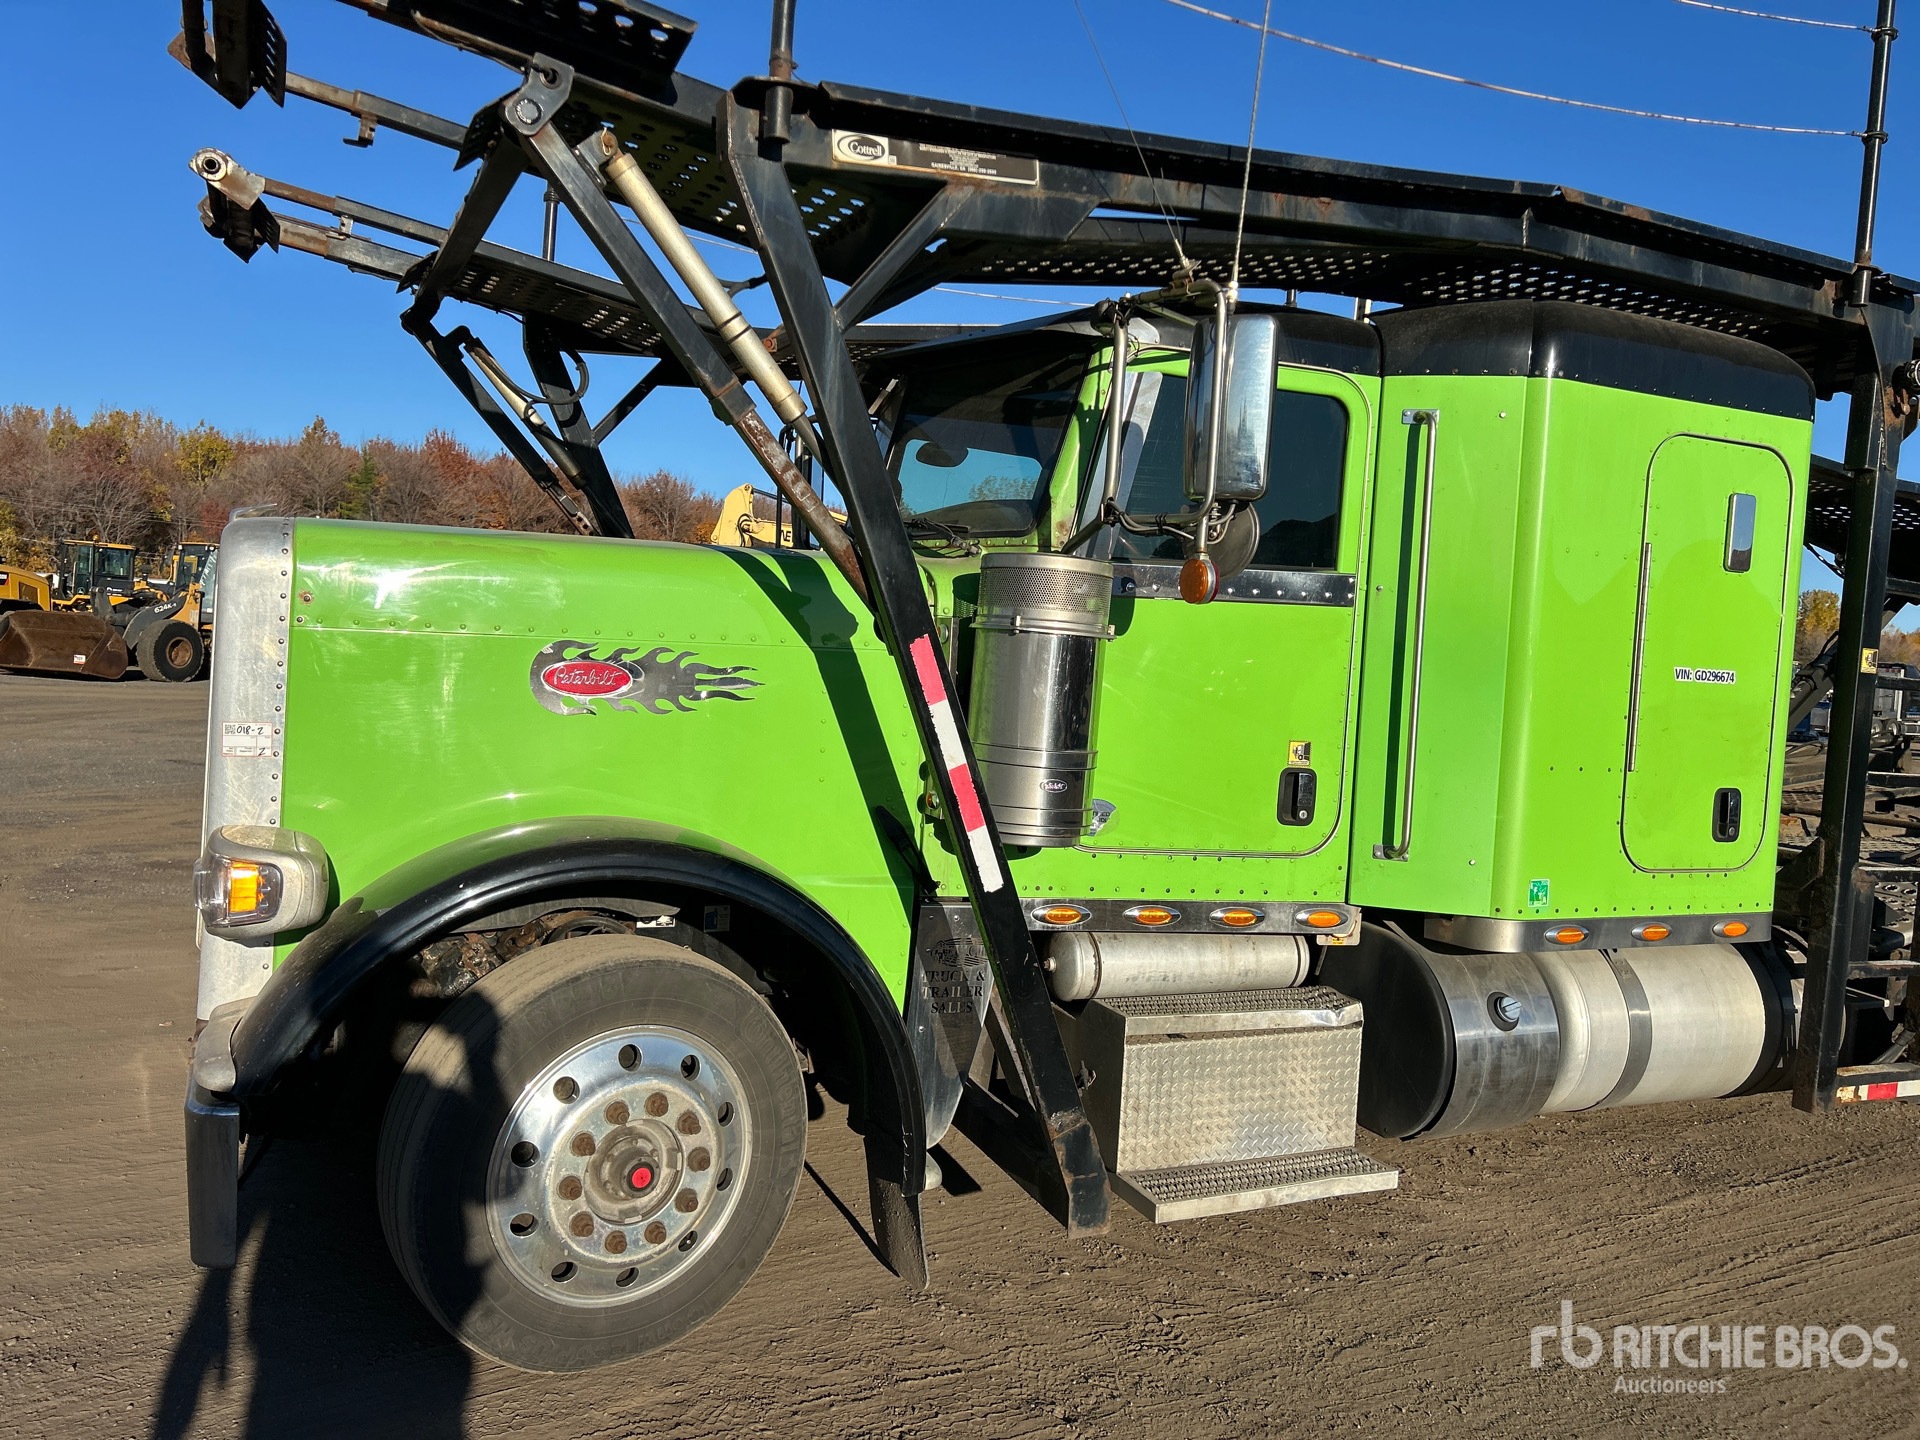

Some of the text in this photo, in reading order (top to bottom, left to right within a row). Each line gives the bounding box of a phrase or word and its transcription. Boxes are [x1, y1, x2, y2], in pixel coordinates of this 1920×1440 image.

[850, 141, 883, 157] Cottrell
[554, 666, 623, 685] Peterbilt
[1675, 668, 1735, 683] VIN: GD296674
[922, 970, 985, 983] TRUCK &
[921, 985, 983, 999] TRAILER
[930, 1001, 973, 1014] SALES
